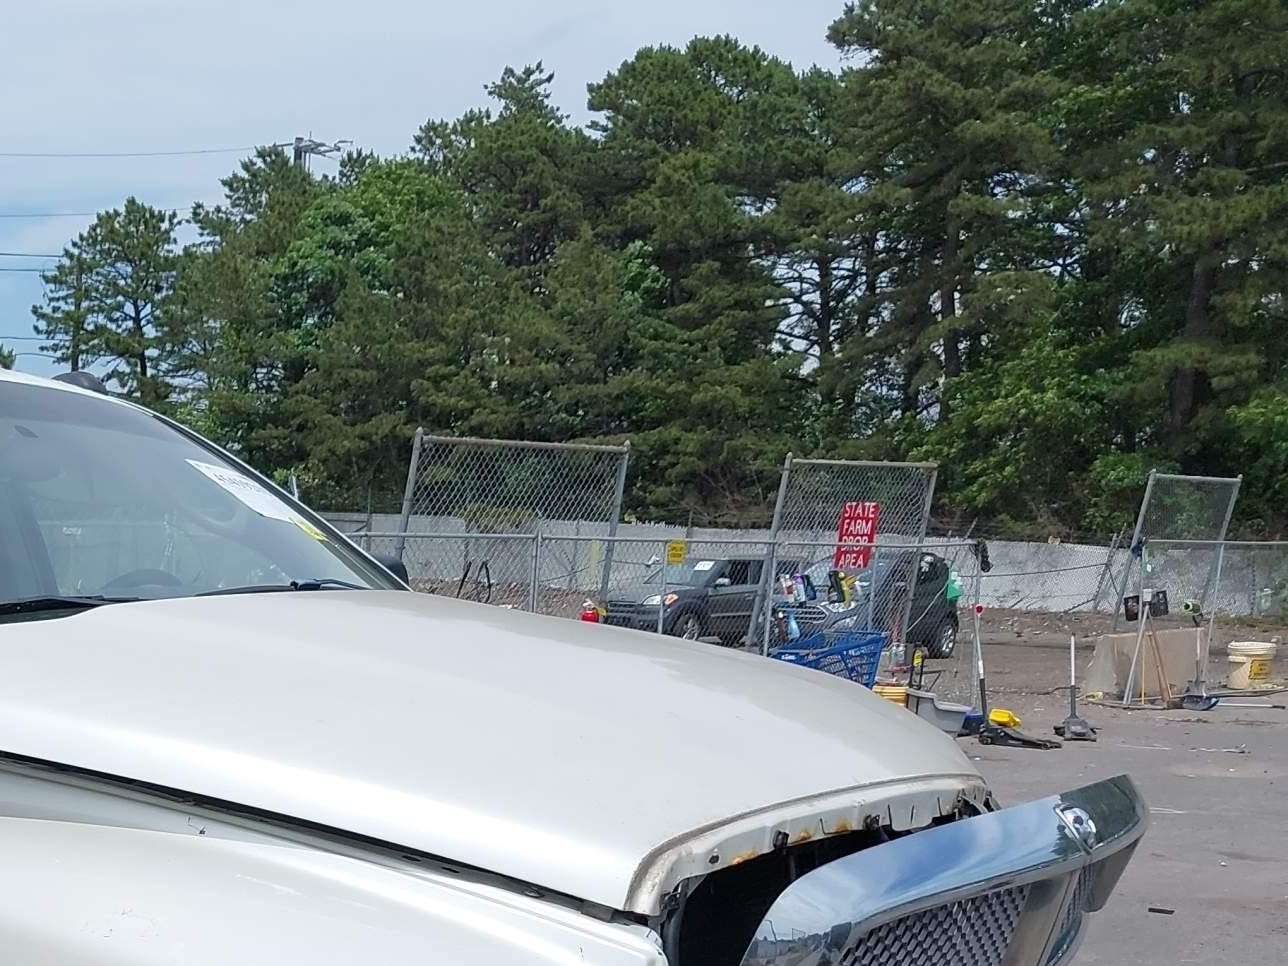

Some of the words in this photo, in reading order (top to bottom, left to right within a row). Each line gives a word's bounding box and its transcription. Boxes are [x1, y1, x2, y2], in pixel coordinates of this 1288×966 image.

[844, 502, 876, 518] STATE
[843, 519, 872, 535] FARM
[838, 552, 864, 568] AREA
